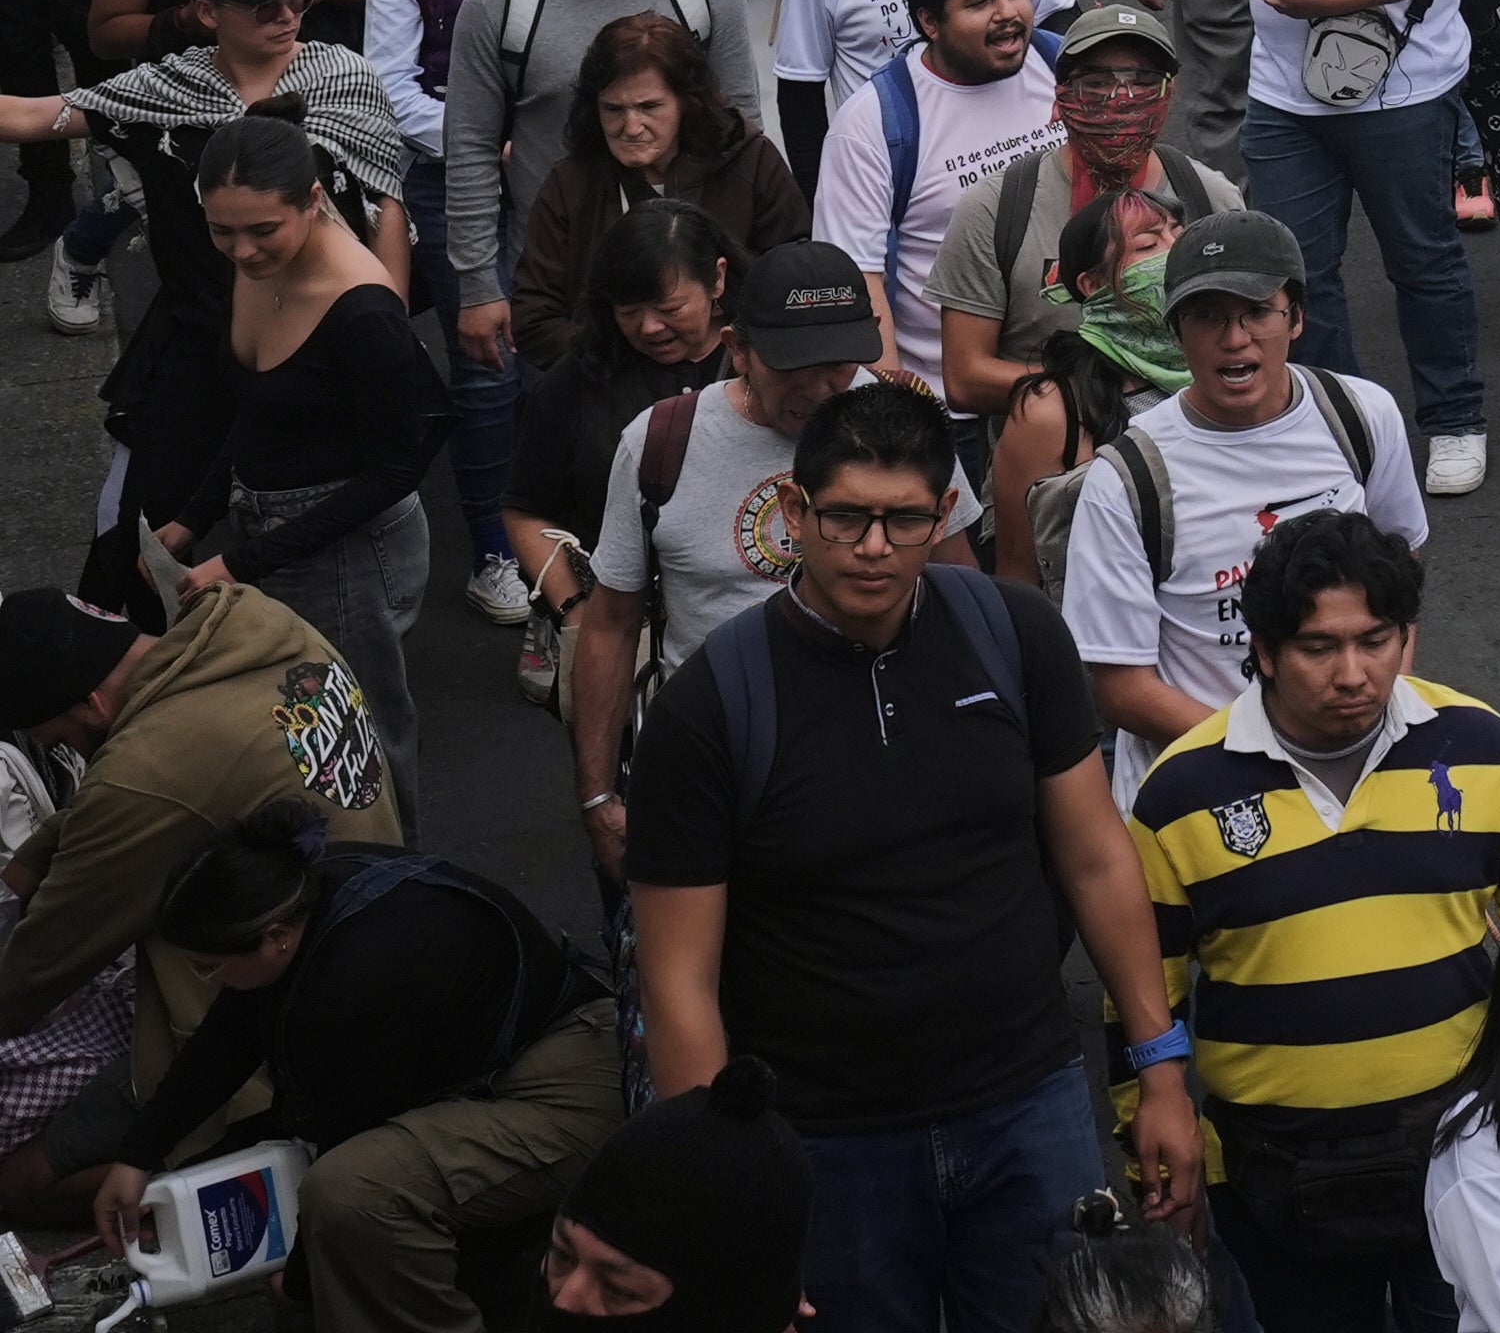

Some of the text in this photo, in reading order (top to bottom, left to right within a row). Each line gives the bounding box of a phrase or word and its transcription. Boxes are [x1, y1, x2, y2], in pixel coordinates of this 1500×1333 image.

[945, 128, 1045, 173] El 2 de octubre de
